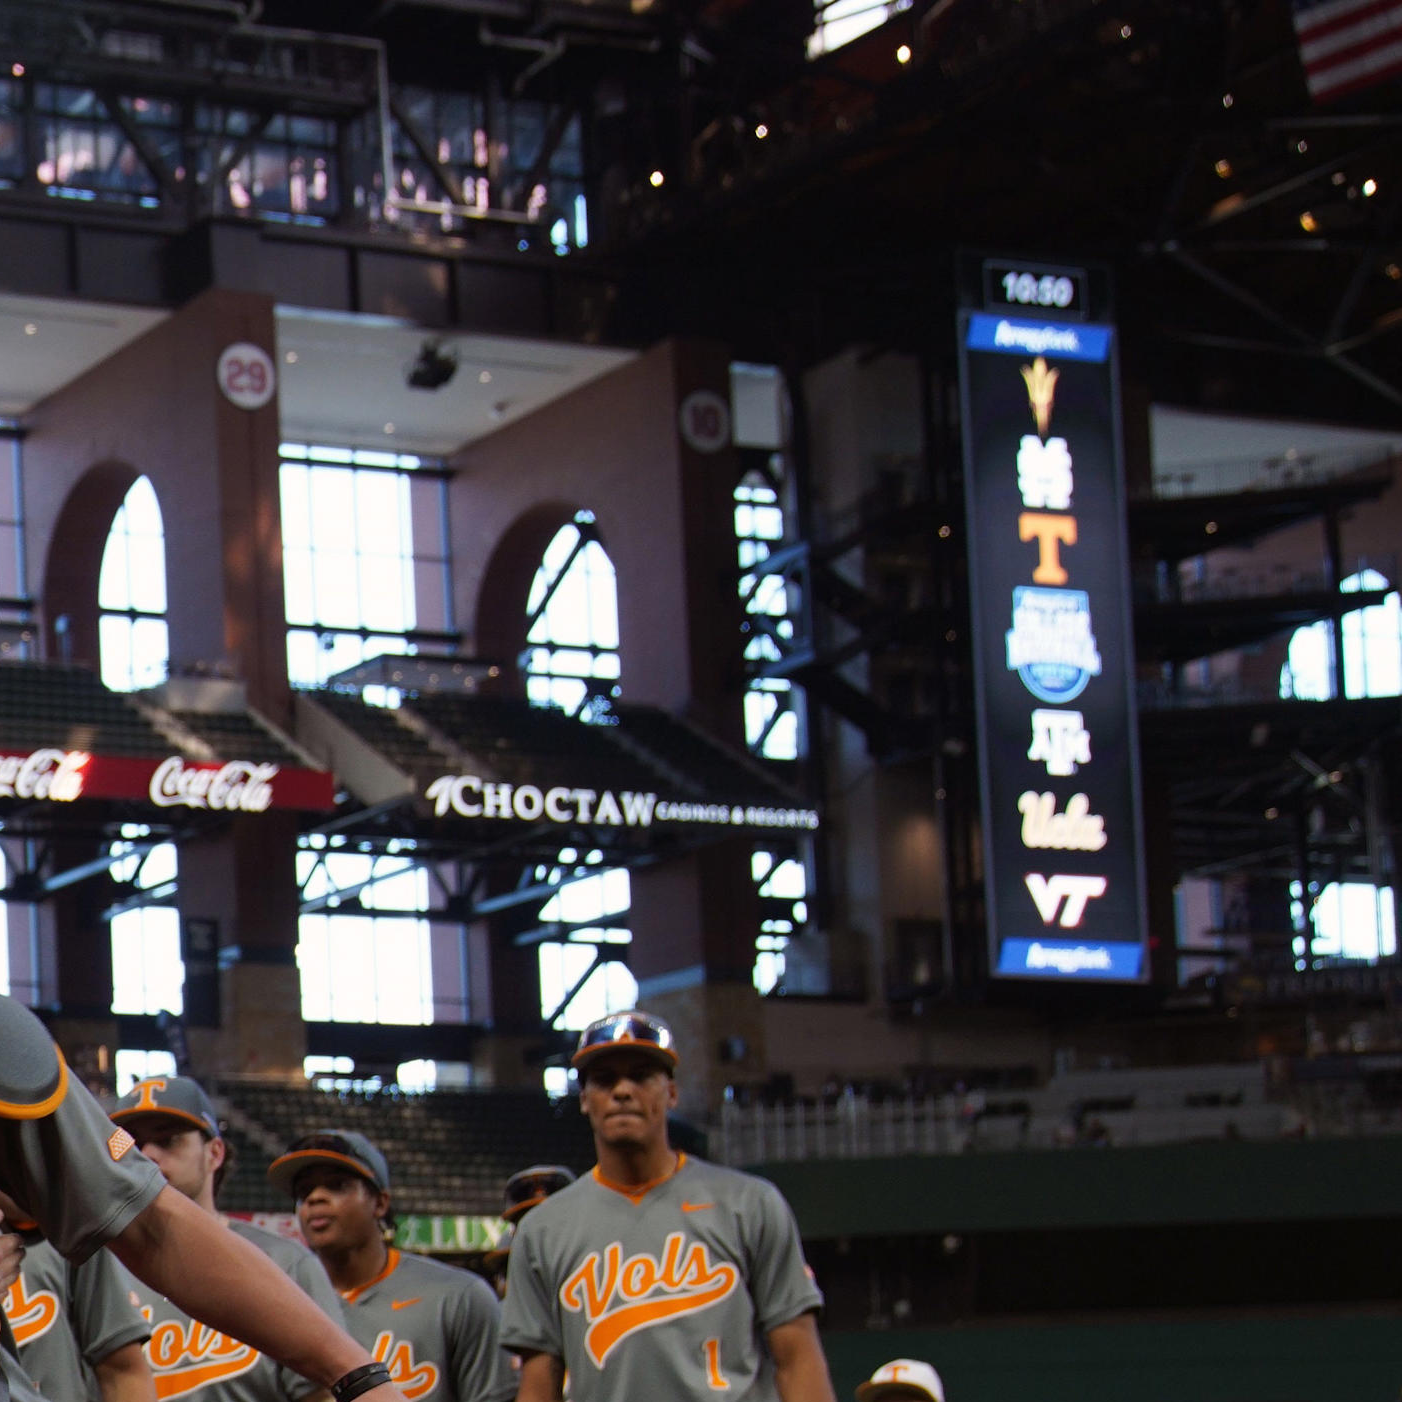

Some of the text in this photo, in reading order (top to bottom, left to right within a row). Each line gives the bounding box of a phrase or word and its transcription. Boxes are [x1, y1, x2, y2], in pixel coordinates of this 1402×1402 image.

[226, 357, 267, 395] 29
[1019, 511, 1078, 585] T
[449, 774, 658, 828] CHOCTAW
[1025, 872, 1108, 929] VT
[559, 1231, 739, 1371] Vols
[702, 1337, 732, 1391] 1
